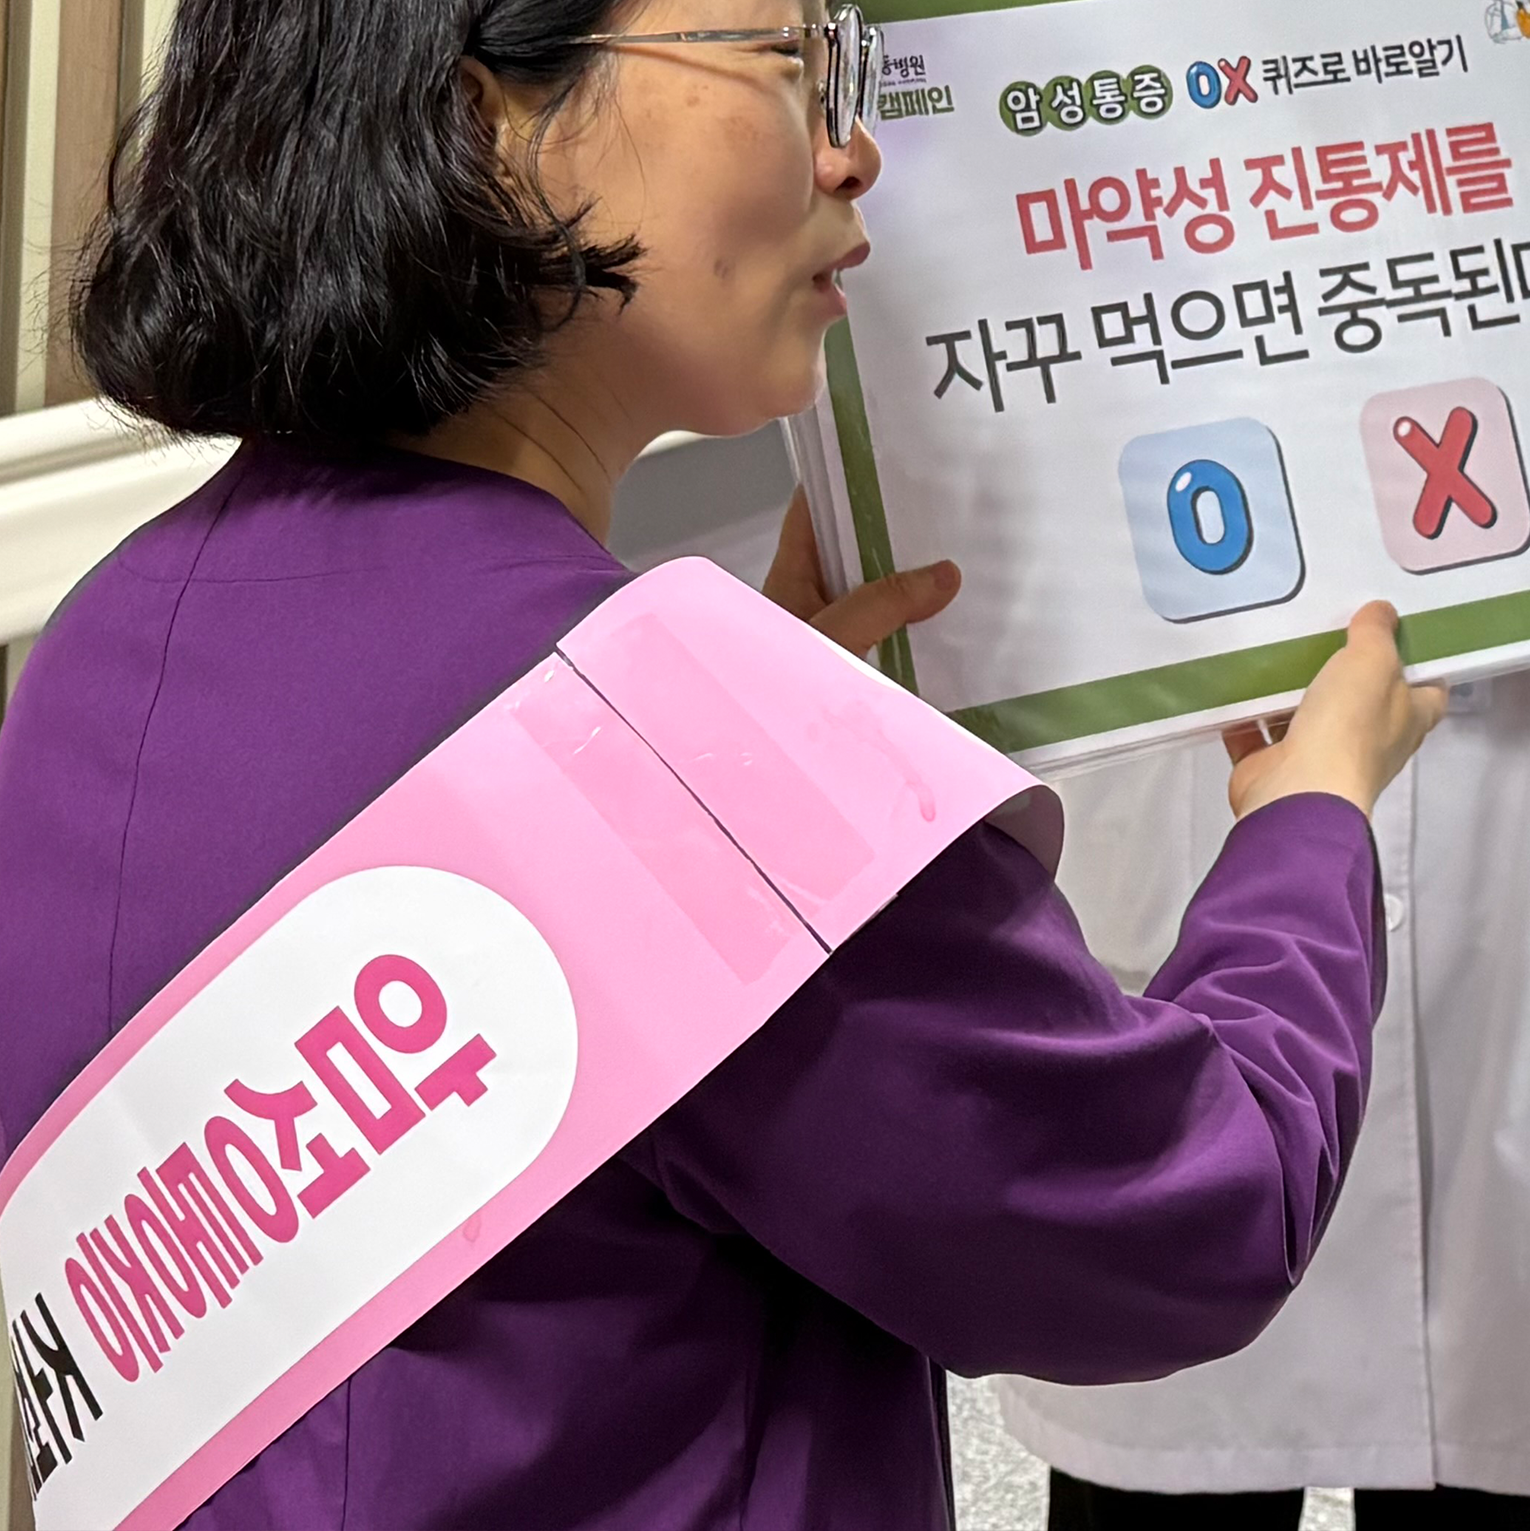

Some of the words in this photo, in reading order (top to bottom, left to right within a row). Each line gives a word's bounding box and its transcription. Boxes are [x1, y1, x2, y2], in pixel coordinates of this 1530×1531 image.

[877, 84, 955, 121] 캠페인
[1003, 71, 1171, 132] 암성통증
[1186, 55, 1259, 109] OX
[1261, 51, 1350, 97] 퀴즈로
[1352, 34, 1469, 78] 바로알기
[1016, 158, 1236, 271] 마약성
[1244, 122, 1514, 241] 진통제를
[924, 312, 1083, 414] 자꾸
[1090, 270, 1311, 386] 먹으면
[1393, 406, 1497, 540] X
[64, 953, 497, 1383] 암성통증
